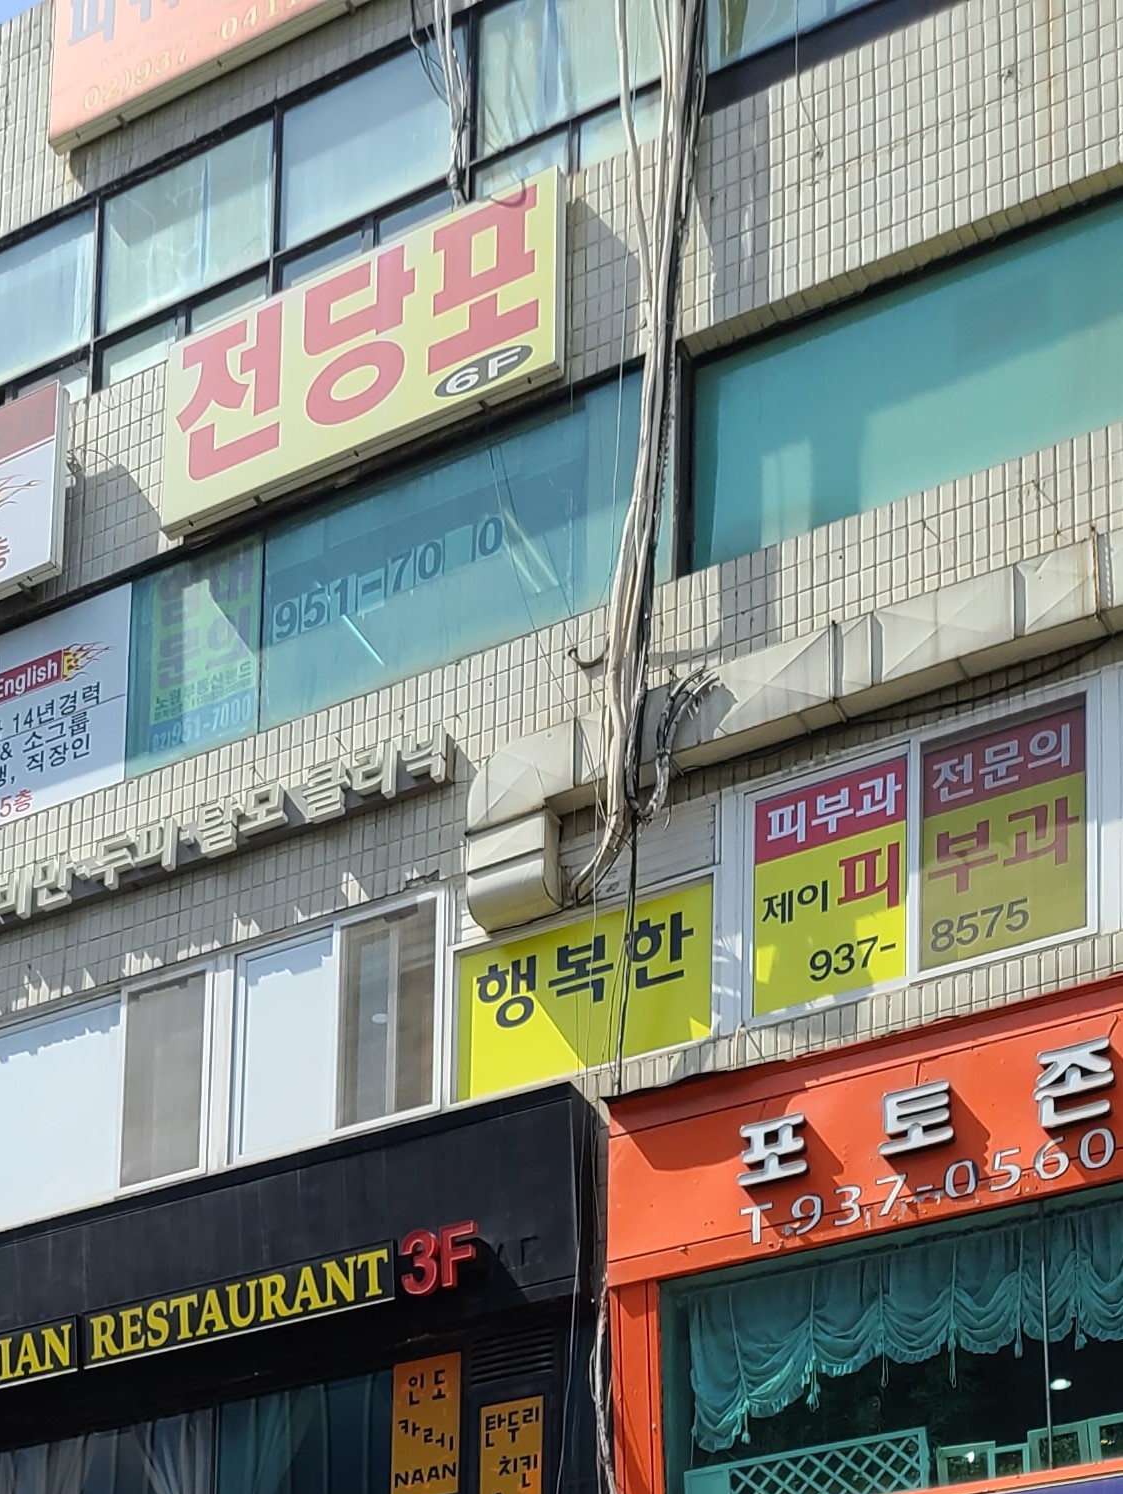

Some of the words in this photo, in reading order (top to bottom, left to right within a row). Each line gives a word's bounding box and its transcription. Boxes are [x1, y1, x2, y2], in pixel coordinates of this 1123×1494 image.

[177, 184, 540, 481] 전당포
[445, 347, 522, 395] 6F
[12, 681, 101, 733] 14년경력
[0, 741, 13, 761] &
[23, 711, 90, 753] 소그룹
[26, 733, 91, 773] 직장인
[302, 723, 456, 824] 클리닉
[931, 723, 1072, 803] 전문의
[0, 788, 33, 818] 5층
[766, 772, 903, 845] 피부과
[477, 911, 695, 1029] 행복한
[736, 1036, 1115, 1188] 포토존
[400, 1220, 477, 1297] 3F
[90, 1247, 388, 1361] RESTAURANT
[408, 1369, 446, 1406] 인도
[398, 1419, 454, 1451] 카레
[485, 1406, 540, 1448] 탄두리
[394, 1462, 457, 1488] NAAN
[499, 1454, 538, 1488] 치킨
